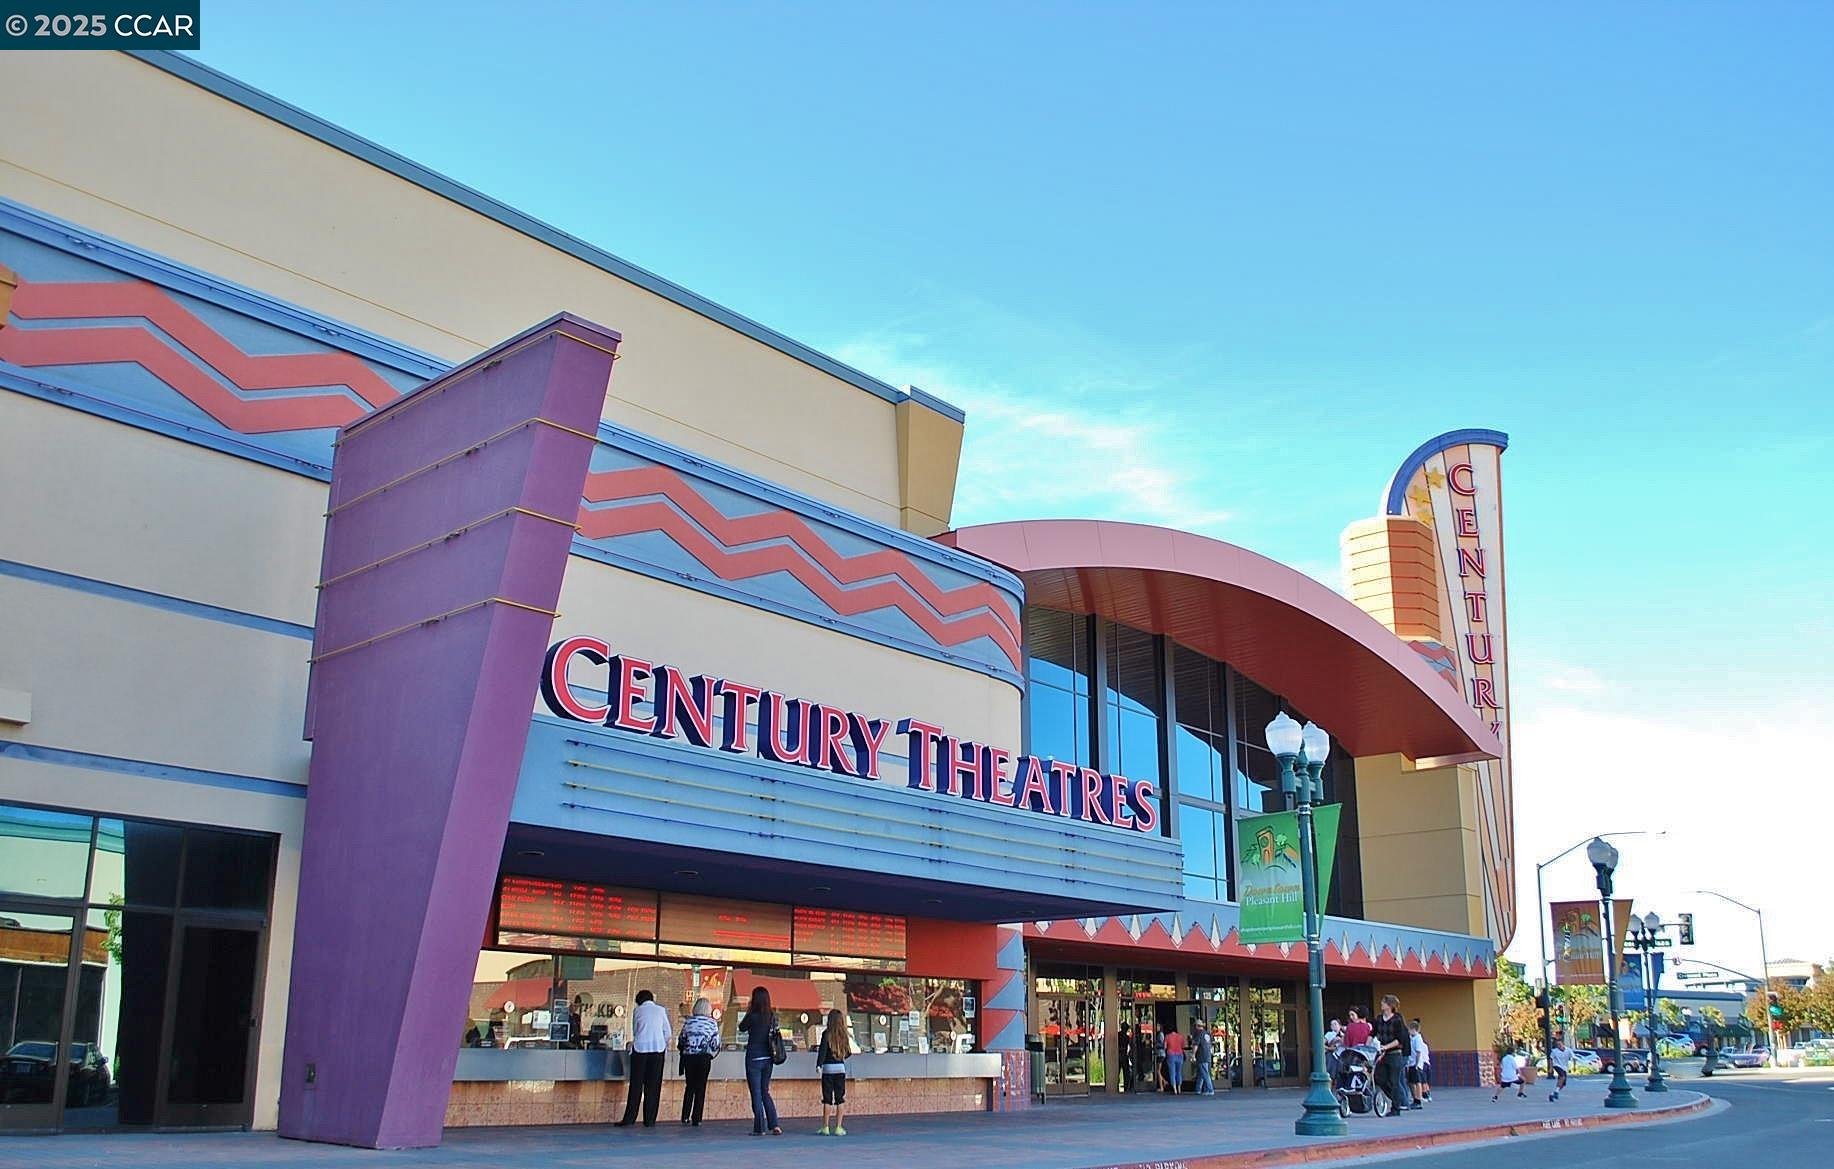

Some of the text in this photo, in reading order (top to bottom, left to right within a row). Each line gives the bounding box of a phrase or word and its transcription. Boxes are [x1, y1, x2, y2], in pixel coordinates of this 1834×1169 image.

[540, 634, 1157, 832] CENTURY THEATRES
[1246, 891, 1298, 906] Pleasant Hill
